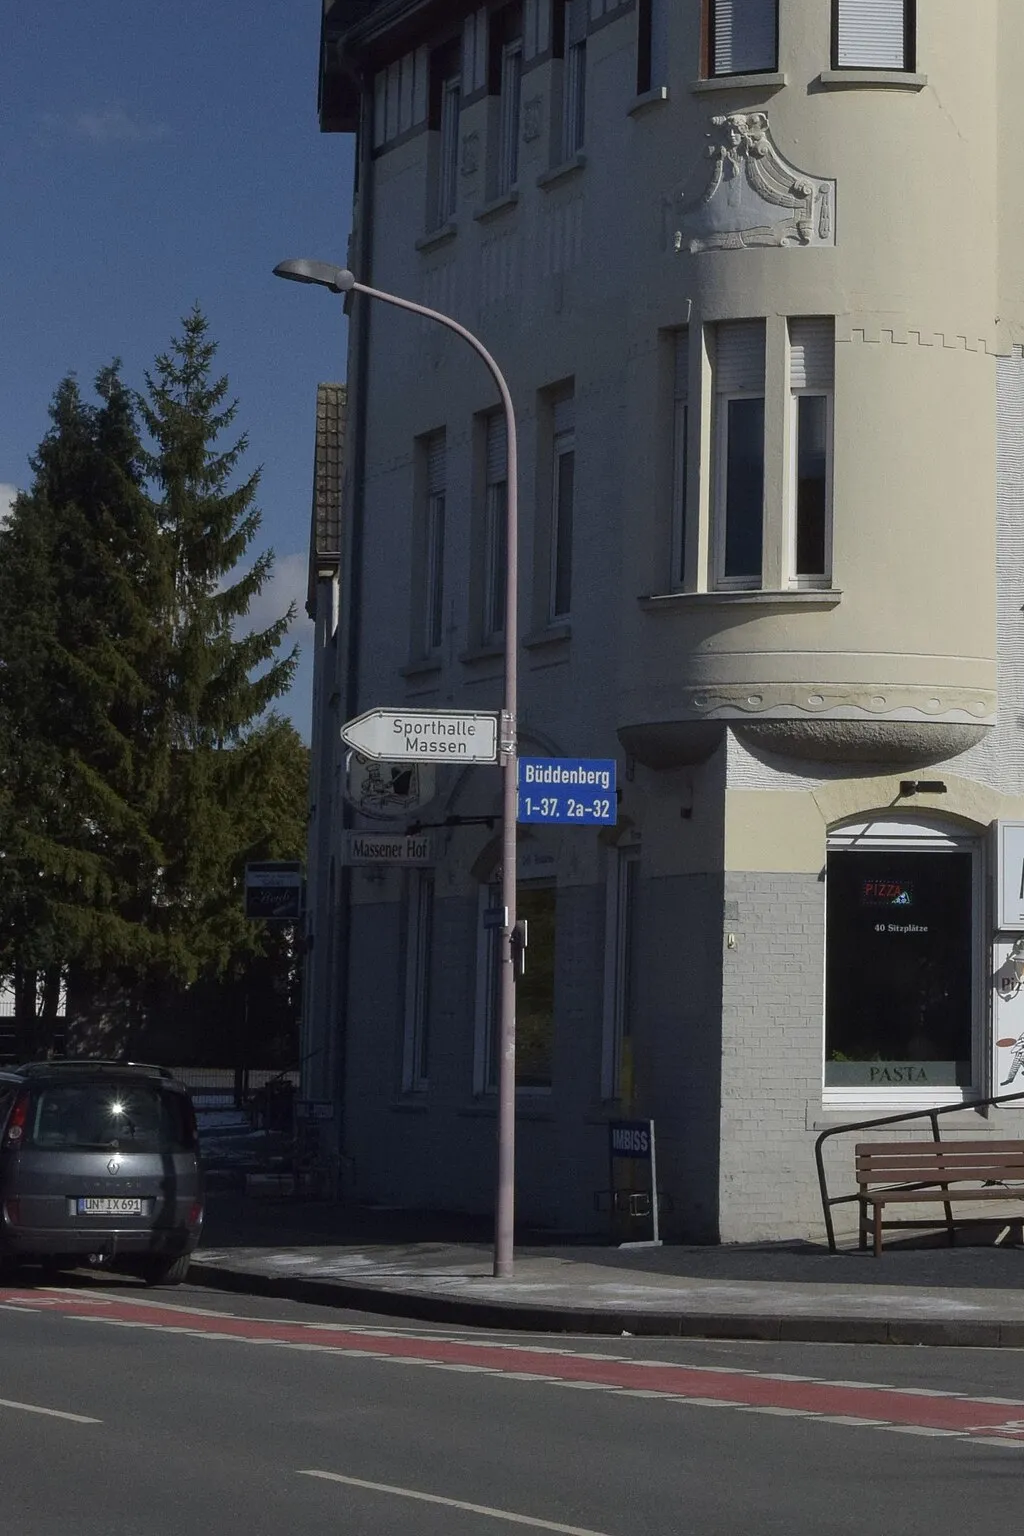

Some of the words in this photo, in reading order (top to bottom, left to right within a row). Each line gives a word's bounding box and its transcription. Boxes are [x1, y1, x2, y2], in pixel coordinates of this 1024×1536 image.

[393, 719, 476, 737] Sporthalle
[405, 738, 467, 754] Massen
[525, 765, 610, 789] Büddenberg
[567, 799, 610, 818] 2a-32
[353, 840, 402, 857] Massener
[407, 839, 427, 857] Hof
[866, 884, 901, 896] PIZZA
[874, 924, 886, 932] 40
[888, 923, 929, 934] Sitzplätze
[870, 1067, 928, 1082] PASTA
[612, 1129, 649, 1152] IMBISS
[85, 1199, 99, 1210] UN
[121, 1200, 140, 1211] 691
